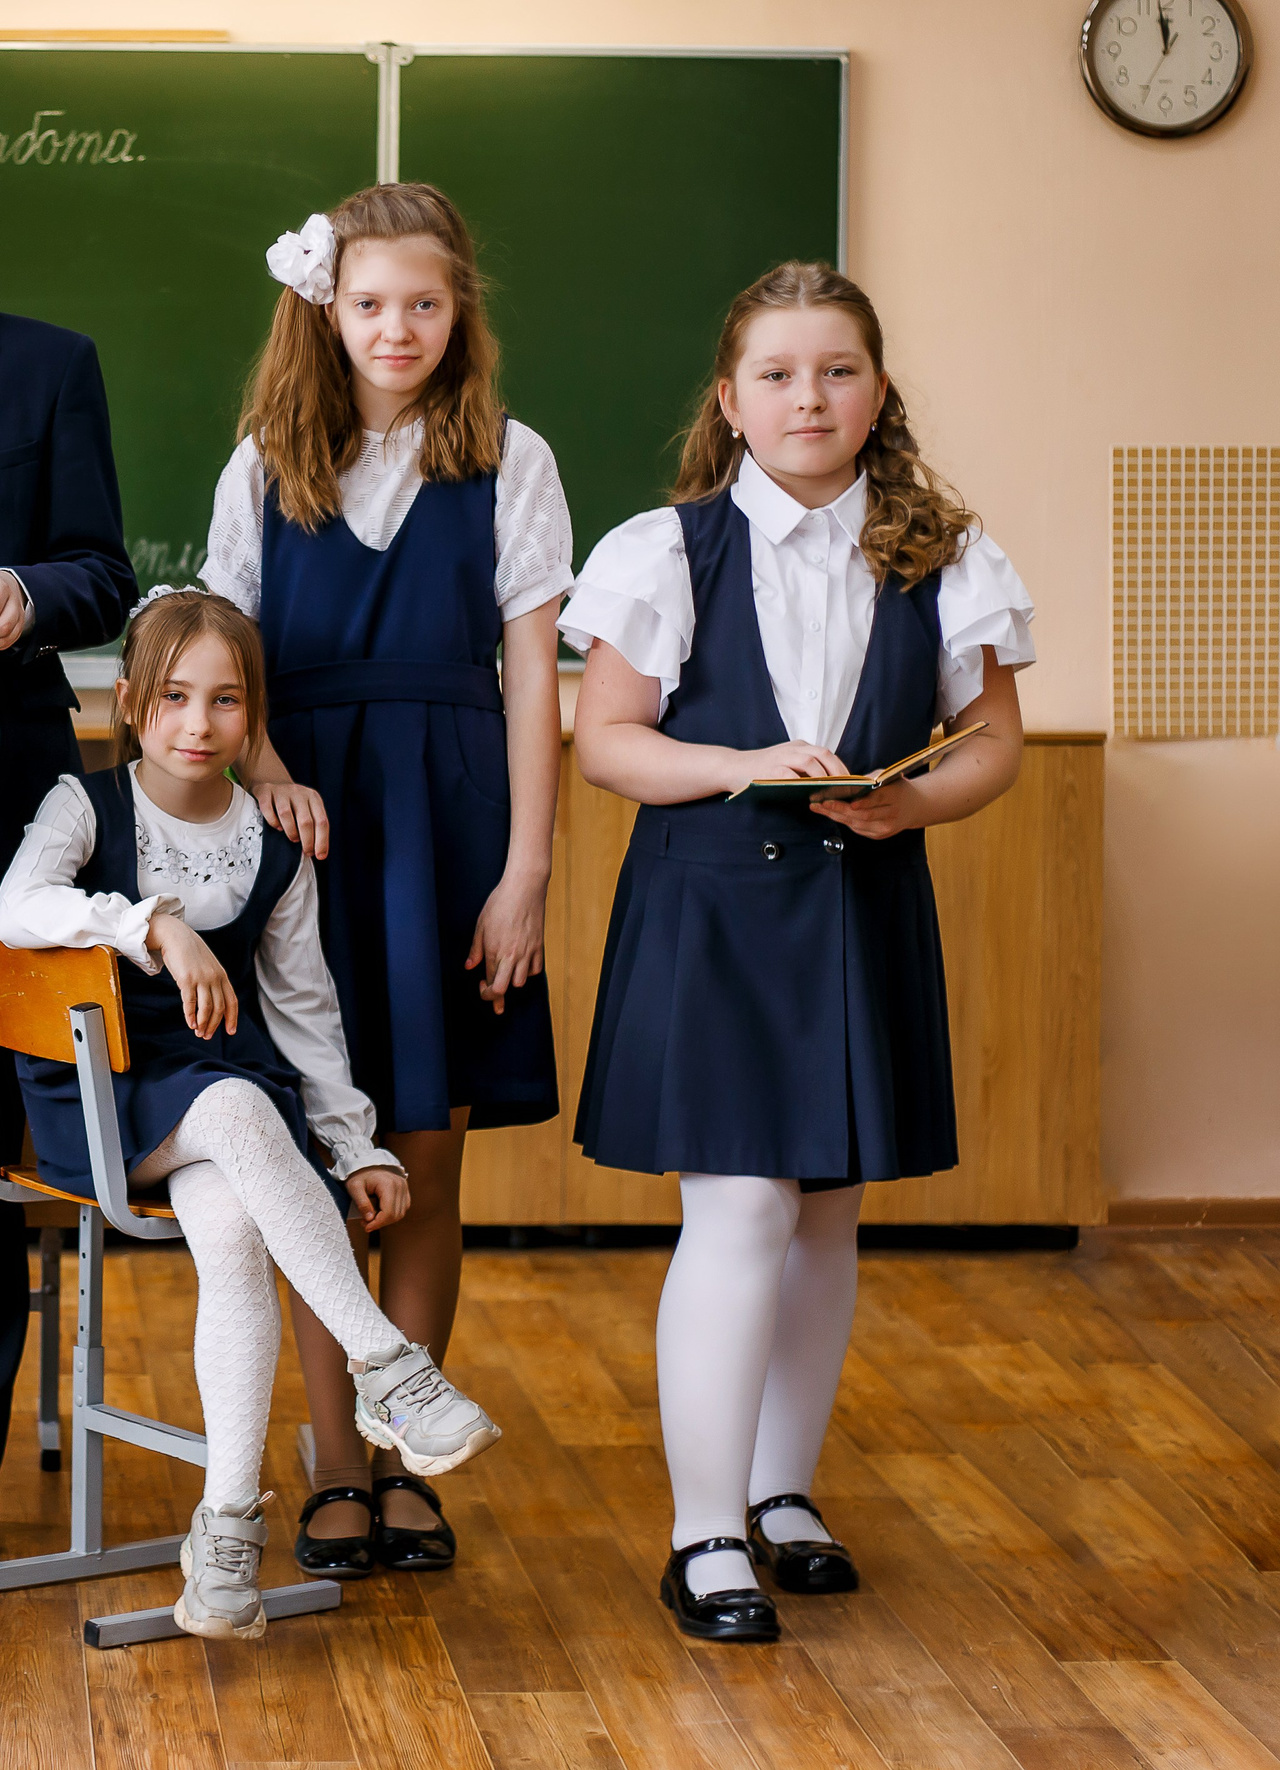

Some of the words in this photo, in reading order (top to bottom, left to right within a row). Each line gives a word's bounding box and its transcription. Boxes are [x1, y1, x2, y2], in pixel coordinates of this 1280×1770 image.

[1116, 16, 1138, 37] 10
[1200, 15, 1217, 37] 2
[1106, 40, 1122, 63] 9
[1209, 41, 1223, 63] 3
[1116, 64, 1131, 87] 8
[1200, 67, 1214, 86] 4
[1156, 92, 1174, 118] 6
[1183, 84, 1199, 107] 5
